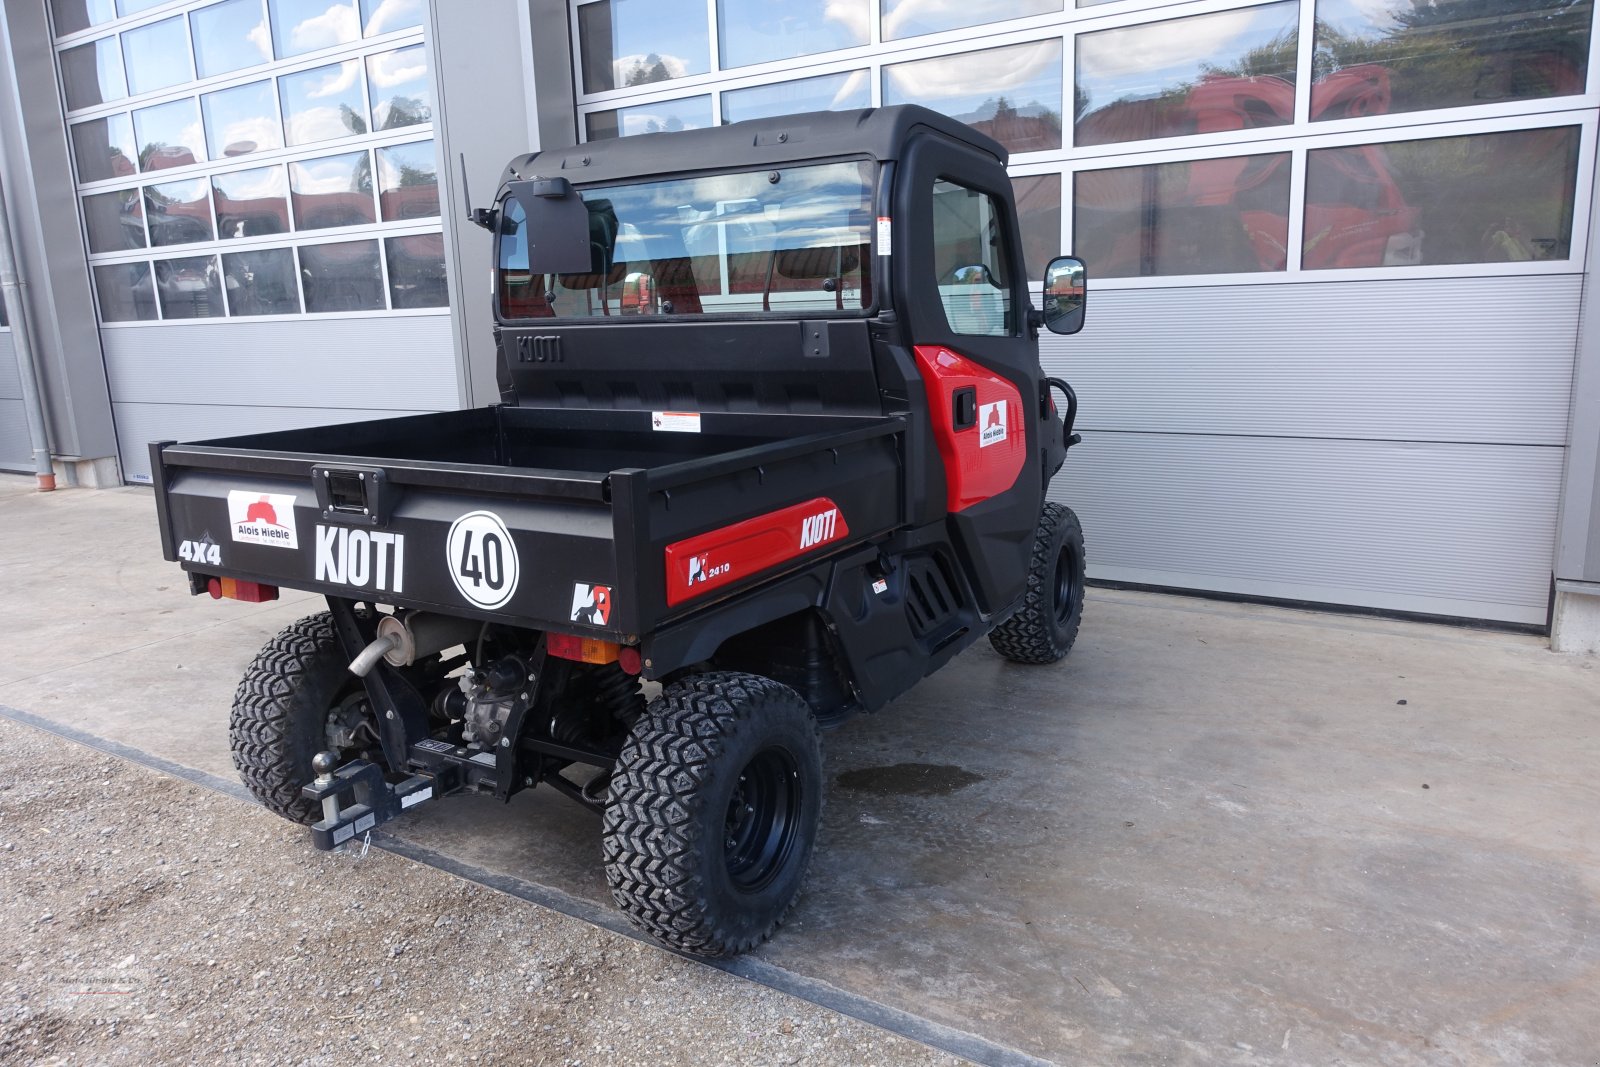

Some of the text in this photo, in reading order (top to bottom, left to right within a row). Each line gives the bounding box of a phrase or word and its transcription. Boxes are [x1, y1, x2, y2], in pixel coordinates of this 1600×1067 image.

[516, 335, 563, 362] KIOTI
[238, 525, 290, 540] Alois Hieble
[800, 508, 837, 550] KIOTI
[315, 524, 404, 593] KIOTI
[460, 529, 505, 591] 40
[708, 562, 730, 578] 2410
